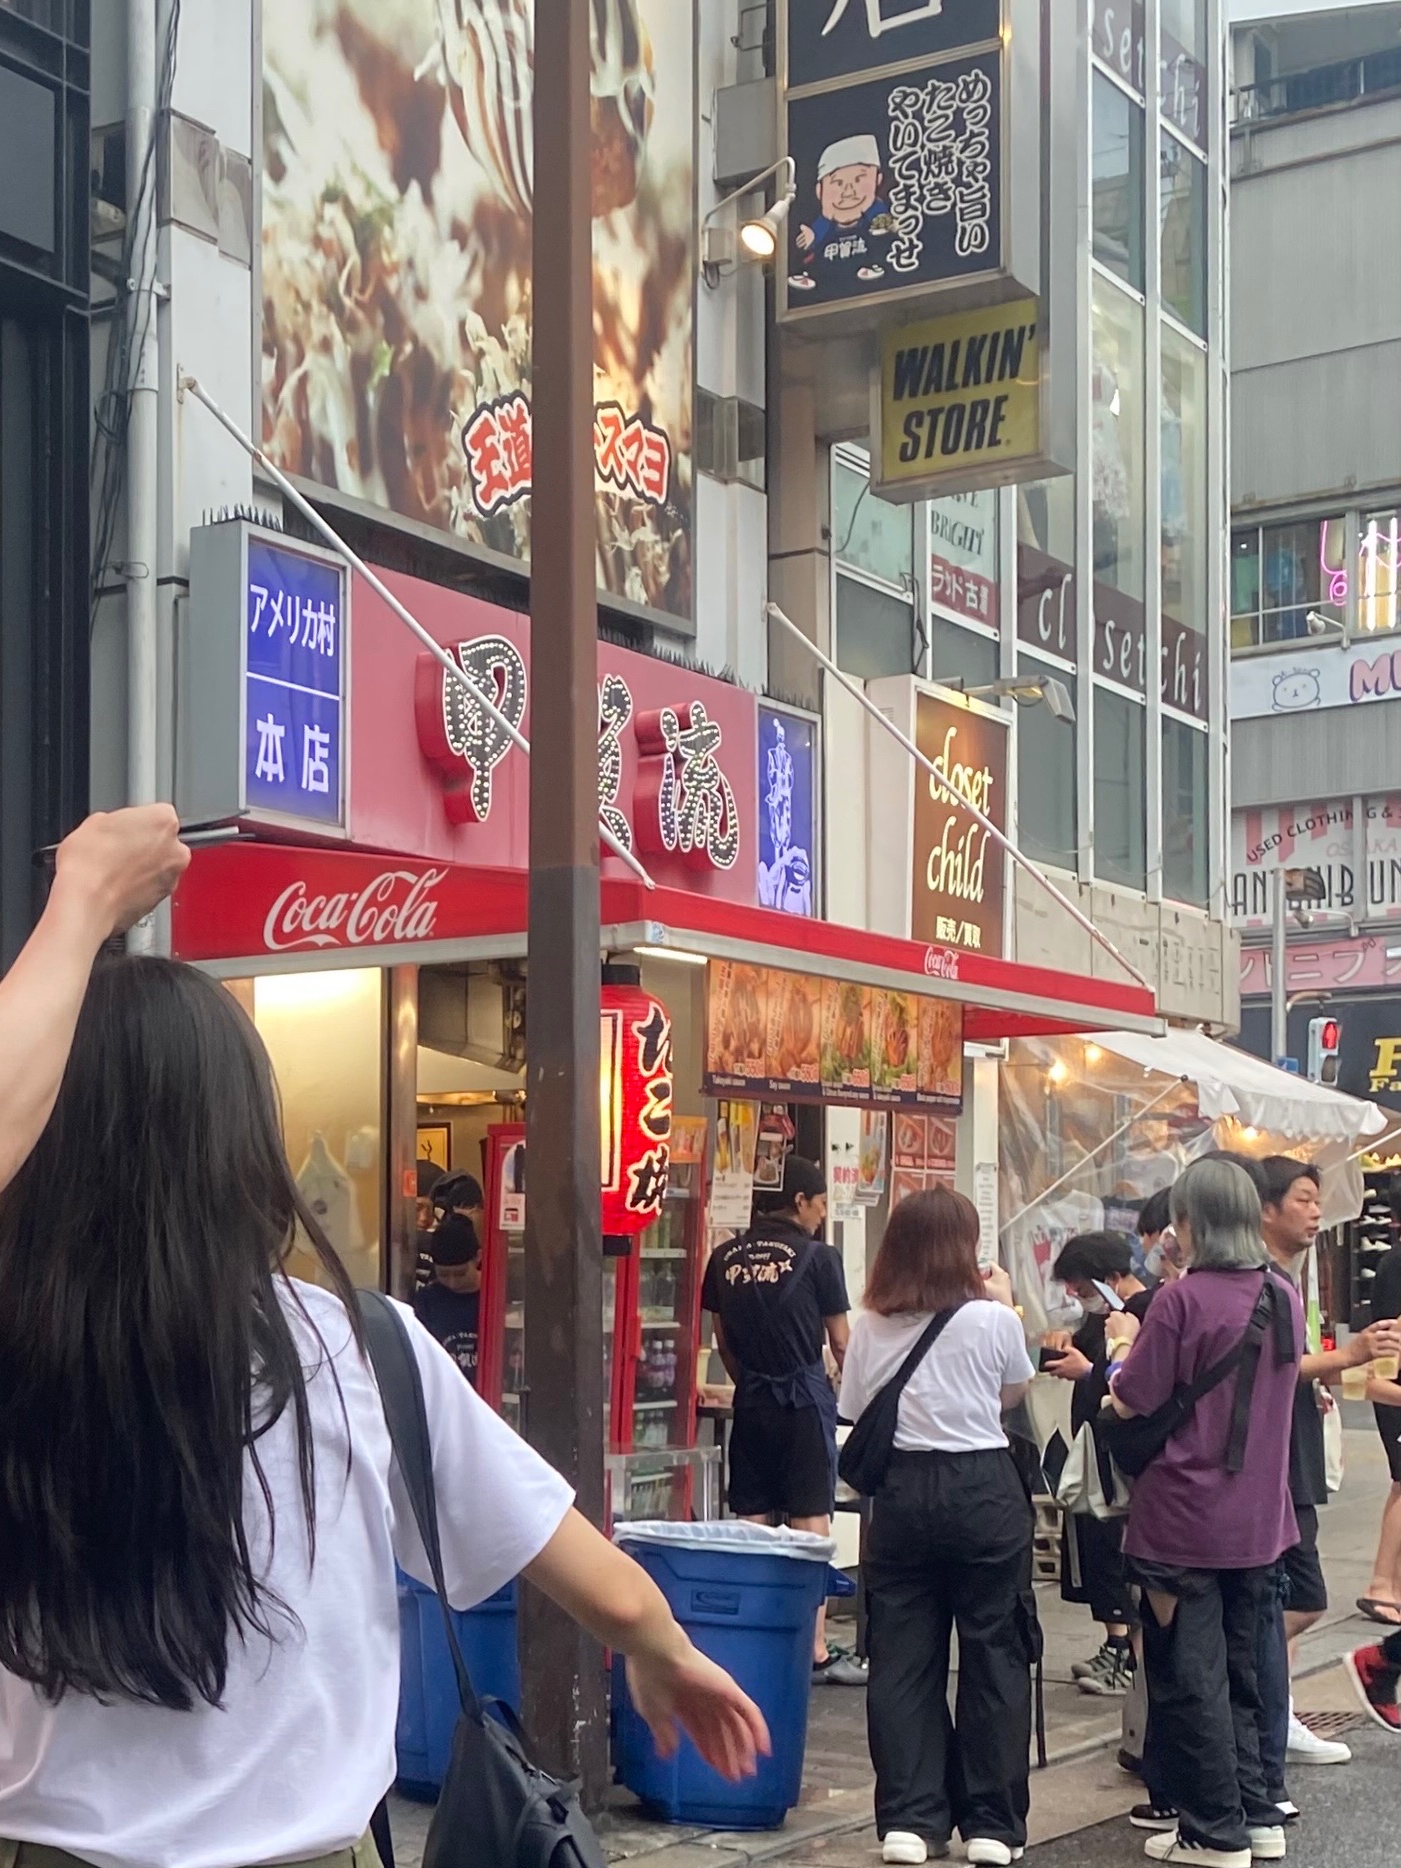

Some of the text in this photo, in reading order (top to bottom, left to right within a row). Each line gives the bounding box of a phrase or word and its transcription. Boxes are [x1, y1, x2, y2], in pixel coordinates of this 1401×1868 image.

[921, 79, 958, 214] たこ焼き
[956, 69, 992, 256] めっちゃ旨い
[893, 324, 1036, 401] WALKIN'
[465, 396, 668, 510] 王道スマヨ
[899, 394, 1009, 462] STORE
[249, 583, 336, 658] アメリカ村
[1038, 573, 1145, 686] clset
[254, 713, 330, 793] 本店
[929, 726, 994, 817] closet
[927, 815, 992, 904] child
[1247, 834, 1284, 863] USED
[263, 867, 450, 950] Coca-Cola
